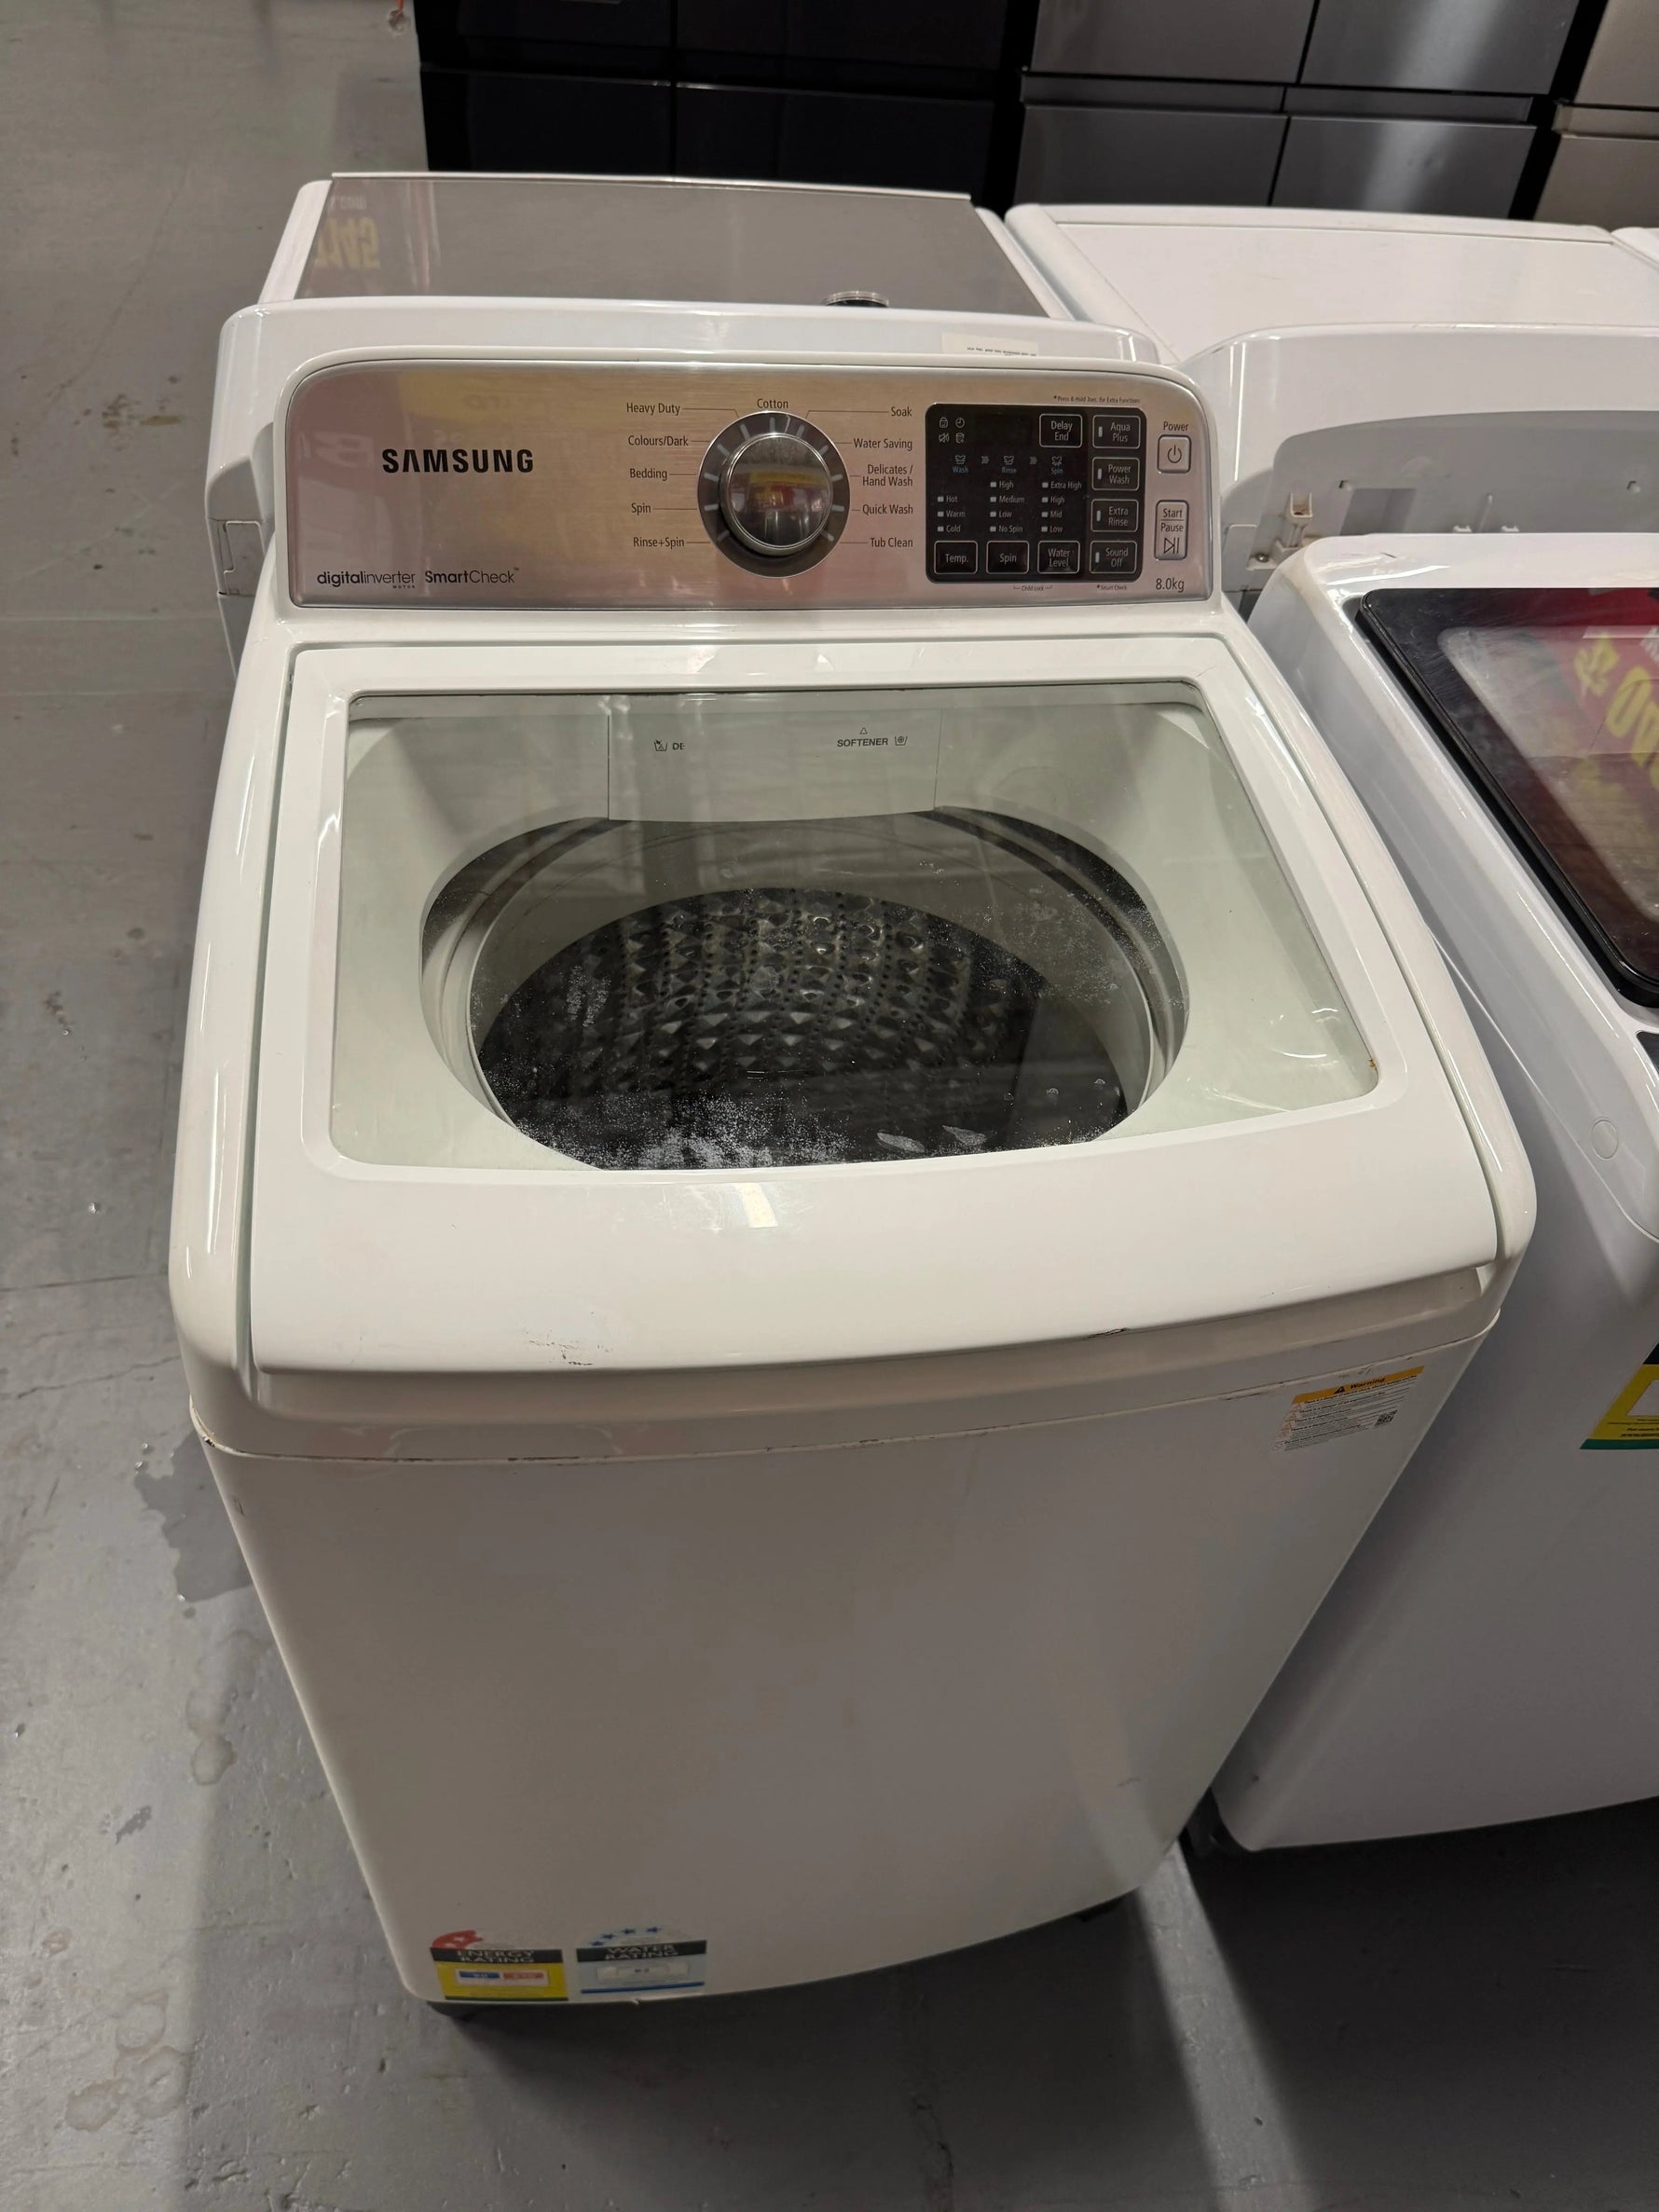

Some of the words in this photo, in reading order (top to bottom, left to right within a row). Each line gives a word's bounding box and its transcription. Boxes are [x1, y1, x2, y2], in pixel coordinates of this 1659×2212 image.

[757, 398, 788, 409] Cotton
[626, 403, 655, 416] Heavy
[658, 403, 680, 416] Duty
[890, 406, 912, 417] Soak
[1050, 420, 1073, 433] Delay
[1110, 421, 1131, 434] Aqua
[1163, 421, 1189, 432] Power
[627, 435, 689, 447] Colours/Dark
[1054, 432, 1069, 441] End
[1112, 433, 1128, 443] Plus
[854, 439, 882, 448] Water
[884, 438, 913, 452] Saving
[382, 448, 533, 474] SAMSUNG
[868, 464, 907, 474] Delicates
[909, 464, 913, 475] /
[1050, 467, 1063, 475] Spin
[1107, 464, 1131, 474] Power
[629, 468, 668, 482] Bedding
[1109, 474, 1130, 484] Wash
[862, 476, 888, 487] Hand
[890, 476, 913, 487] Wash
[999, 481, 1014, 490] High
[1050, 481, 1066, 489] Extra
[1067, 481, 1082, 490] High
[1050, 496, 1065, 505] High
[631, 503, 651, 516] Spin
[862, 503, 887, 516] Quick
[889, 504, 913, 515] Wash
[1108, 506, 1129, 515] Extra
[1163, 507, 1183, 518] Start
[1108, 517, 1129, 527] Rinse
[1160, 522, 1184, 532] Pause
[1008, 525, 1023, 534] Spin
[633, 537, 685, 550] Rinse+Spin
[871, 537, 886, 548] Tub
[888, 537, 913, 548] Clean
[1048, 548, 1071, 557] Water
[1105, 547, 1129, 557] Sound
[945, 553, 969, 565] Temp.
[999, 553, 1017, 565] Spin
[1049, 557, 1069, 567] Level
[1111, 557, 1123, 568] Off
[317, 570, 416, 587] digitalinverter
[1156, 577, 1185, 593] 8.0kg
[837, 737, 888, 748] SOFTENER
[1351, 1378, 1386, 1389] Warning
[607, 1944, 675, 1954] WATER
